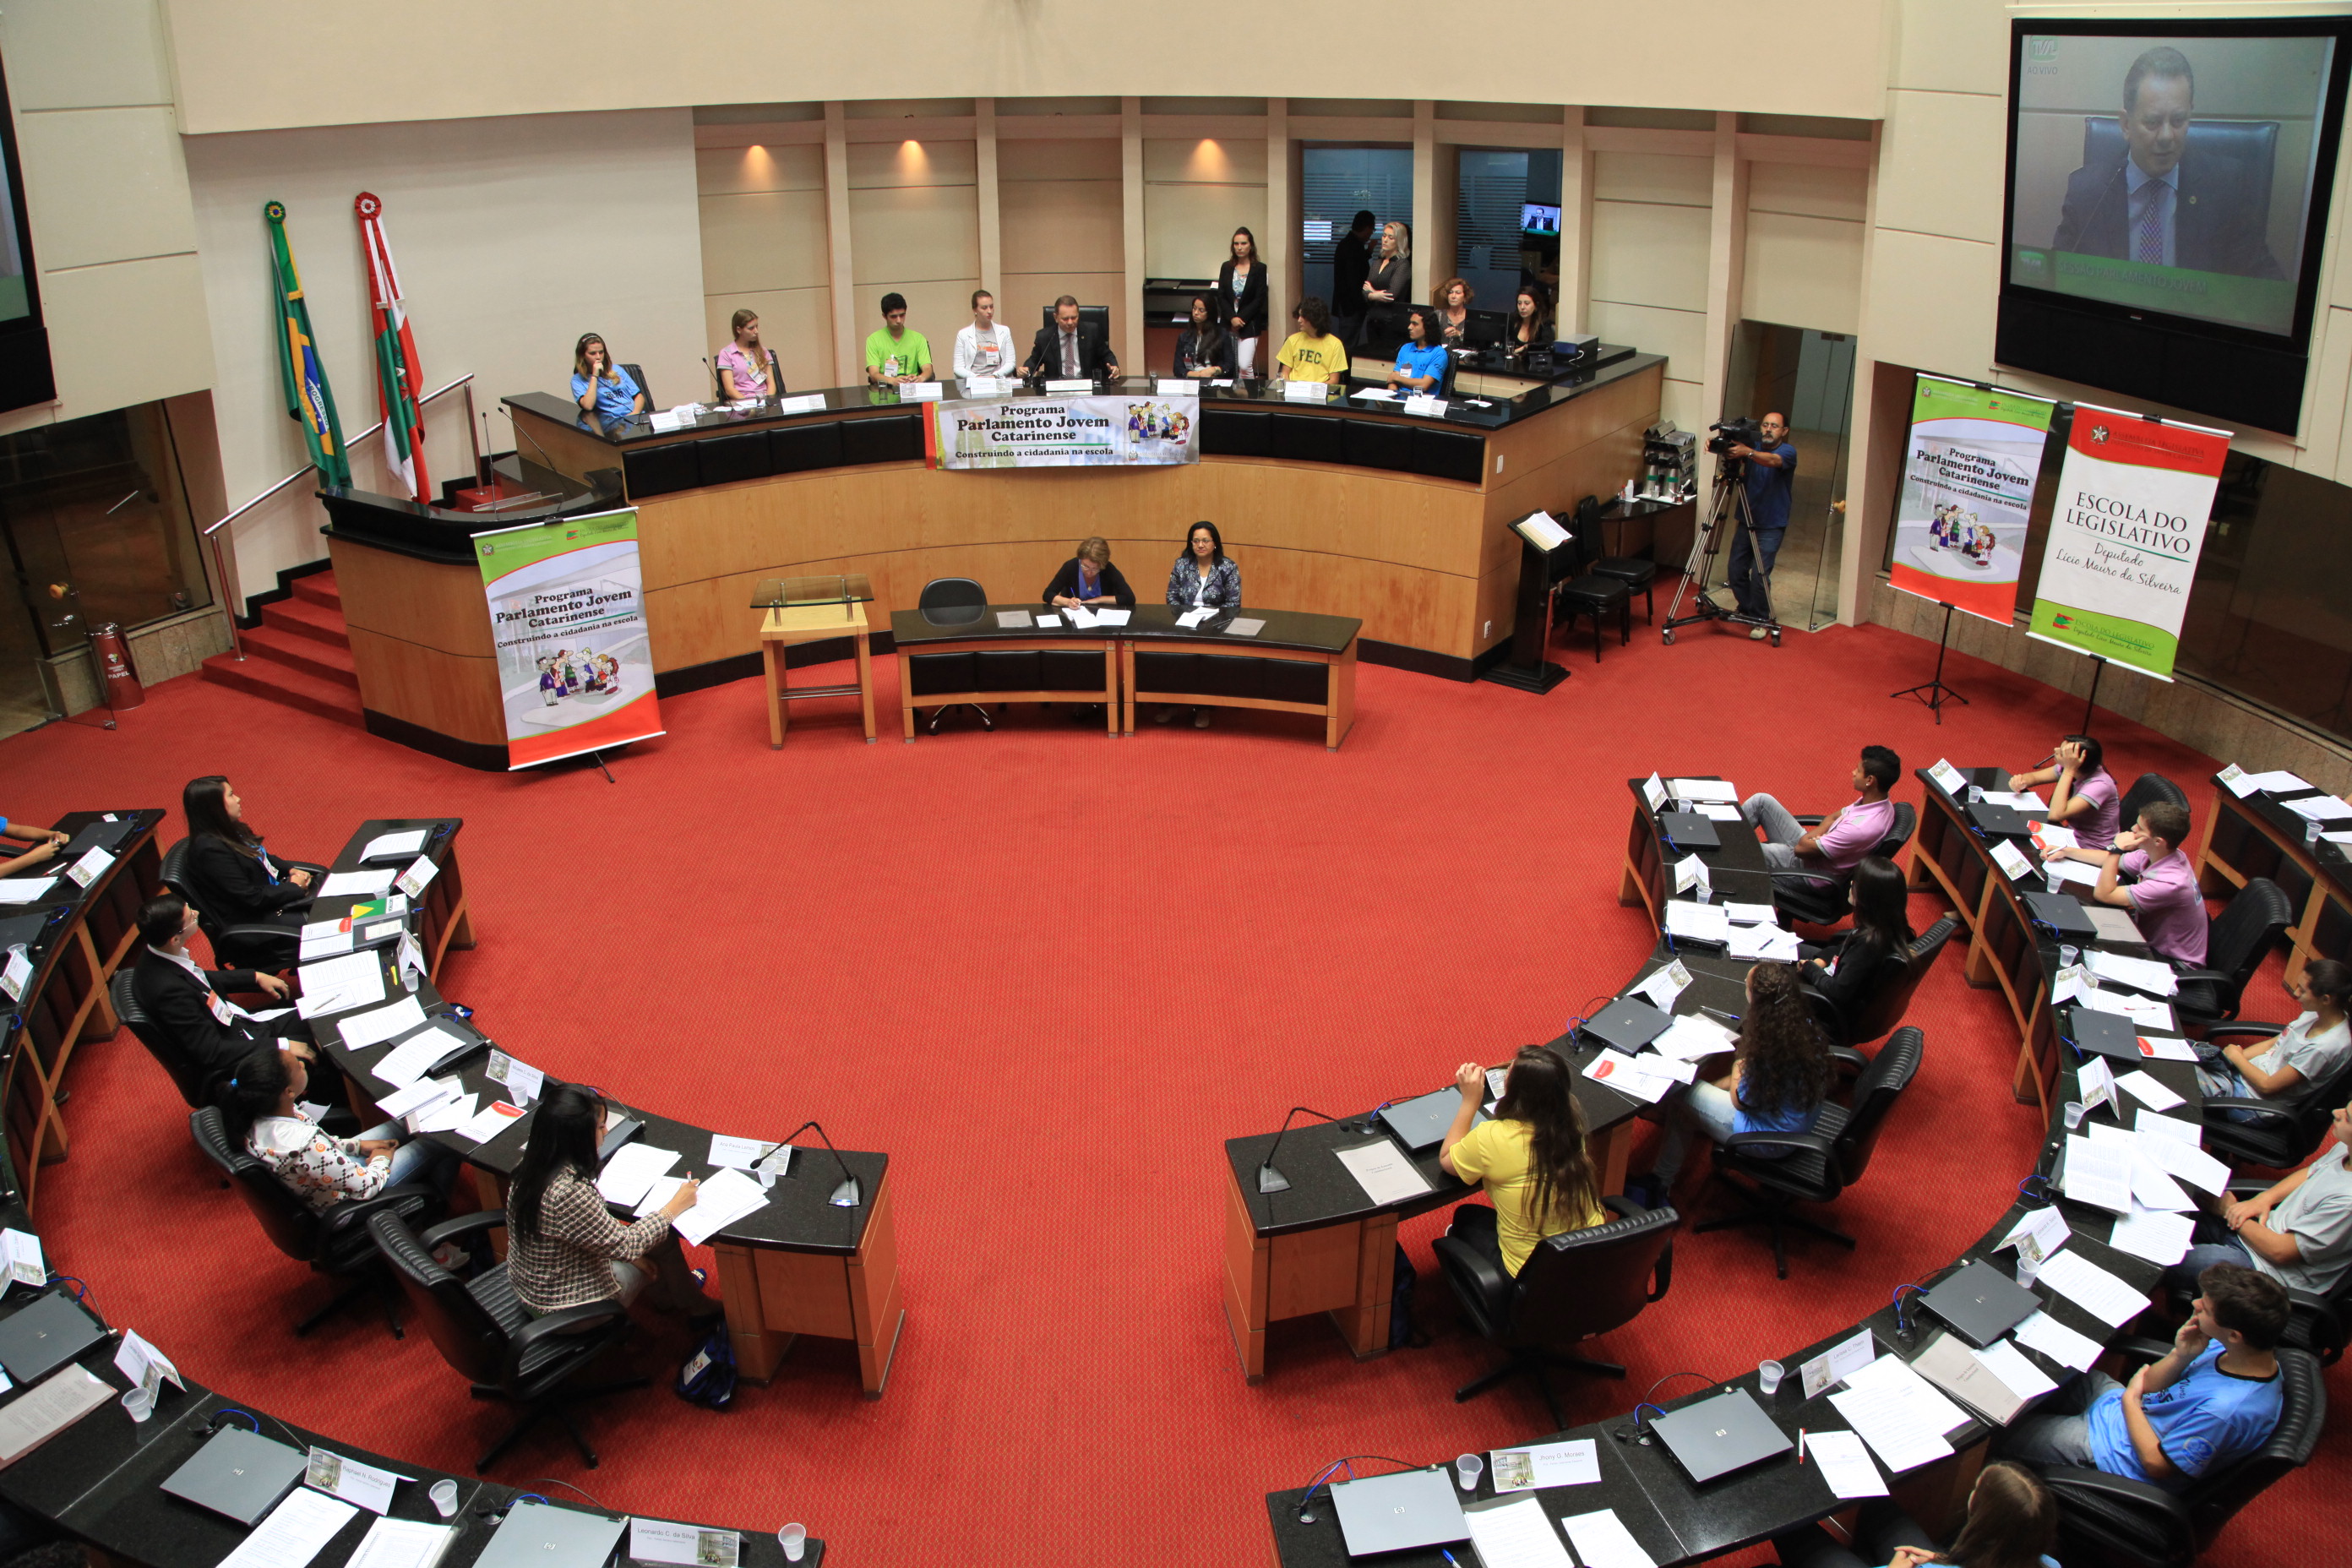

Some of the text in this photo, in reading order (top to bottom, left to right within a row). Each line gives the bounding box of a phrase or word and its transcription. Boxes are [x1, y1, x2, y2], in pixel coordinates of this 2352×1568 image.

[2039, 67, 2058, 75] VIVO
[2096, 270, 2167, 286] PARLAMENTO
[2169, 276, 2208, 292] JOVEM
[309, 383, 329, 426] ROGRESSO
[1000, 406, 1065, 416] Programa
[957, 416, 1109, 431] Parlamento Jovem
[991, 431, 1076, 442] Catarinense
[955, 449, 1015, 459] Construindo
[1949, 448, 1995, 466] Programa
[1916, 450, 2029, 487] Parlamento Jovem
[1939, 466, 2001, 490] Catarinense
[1910, 475, 1952, 490] Construindo
[1958, 488, 1992, 502] cidadania
[2004, 500, 2027, 510] escola
[2076, 492, 2187, 532] ESCOLA DO
[2066, 509, 2191, 553] LEGISLATIVO
[2094, 542, 2144, 567] Deputado
[2056, 548, 2181, 595] Lício Mauro da Silveira
[496, 591, 633, 623] Parlamento Jovem
[534, 588, 593, 604] Programa
[528, 607, 605, 628] Catarinense
[498, 633, 552, 648] Construindo
[560, 623, 601, 637] cidadania
[613, 615, 639, 625] escola
[2075, 618, 2099, 632] ESCOLA
[2112, 630, 2155, 648] LEGISLATIVO
[368, 1474, 391, 1488] Rodrigues
[637, 1527, 664, 1537] Leonardo
